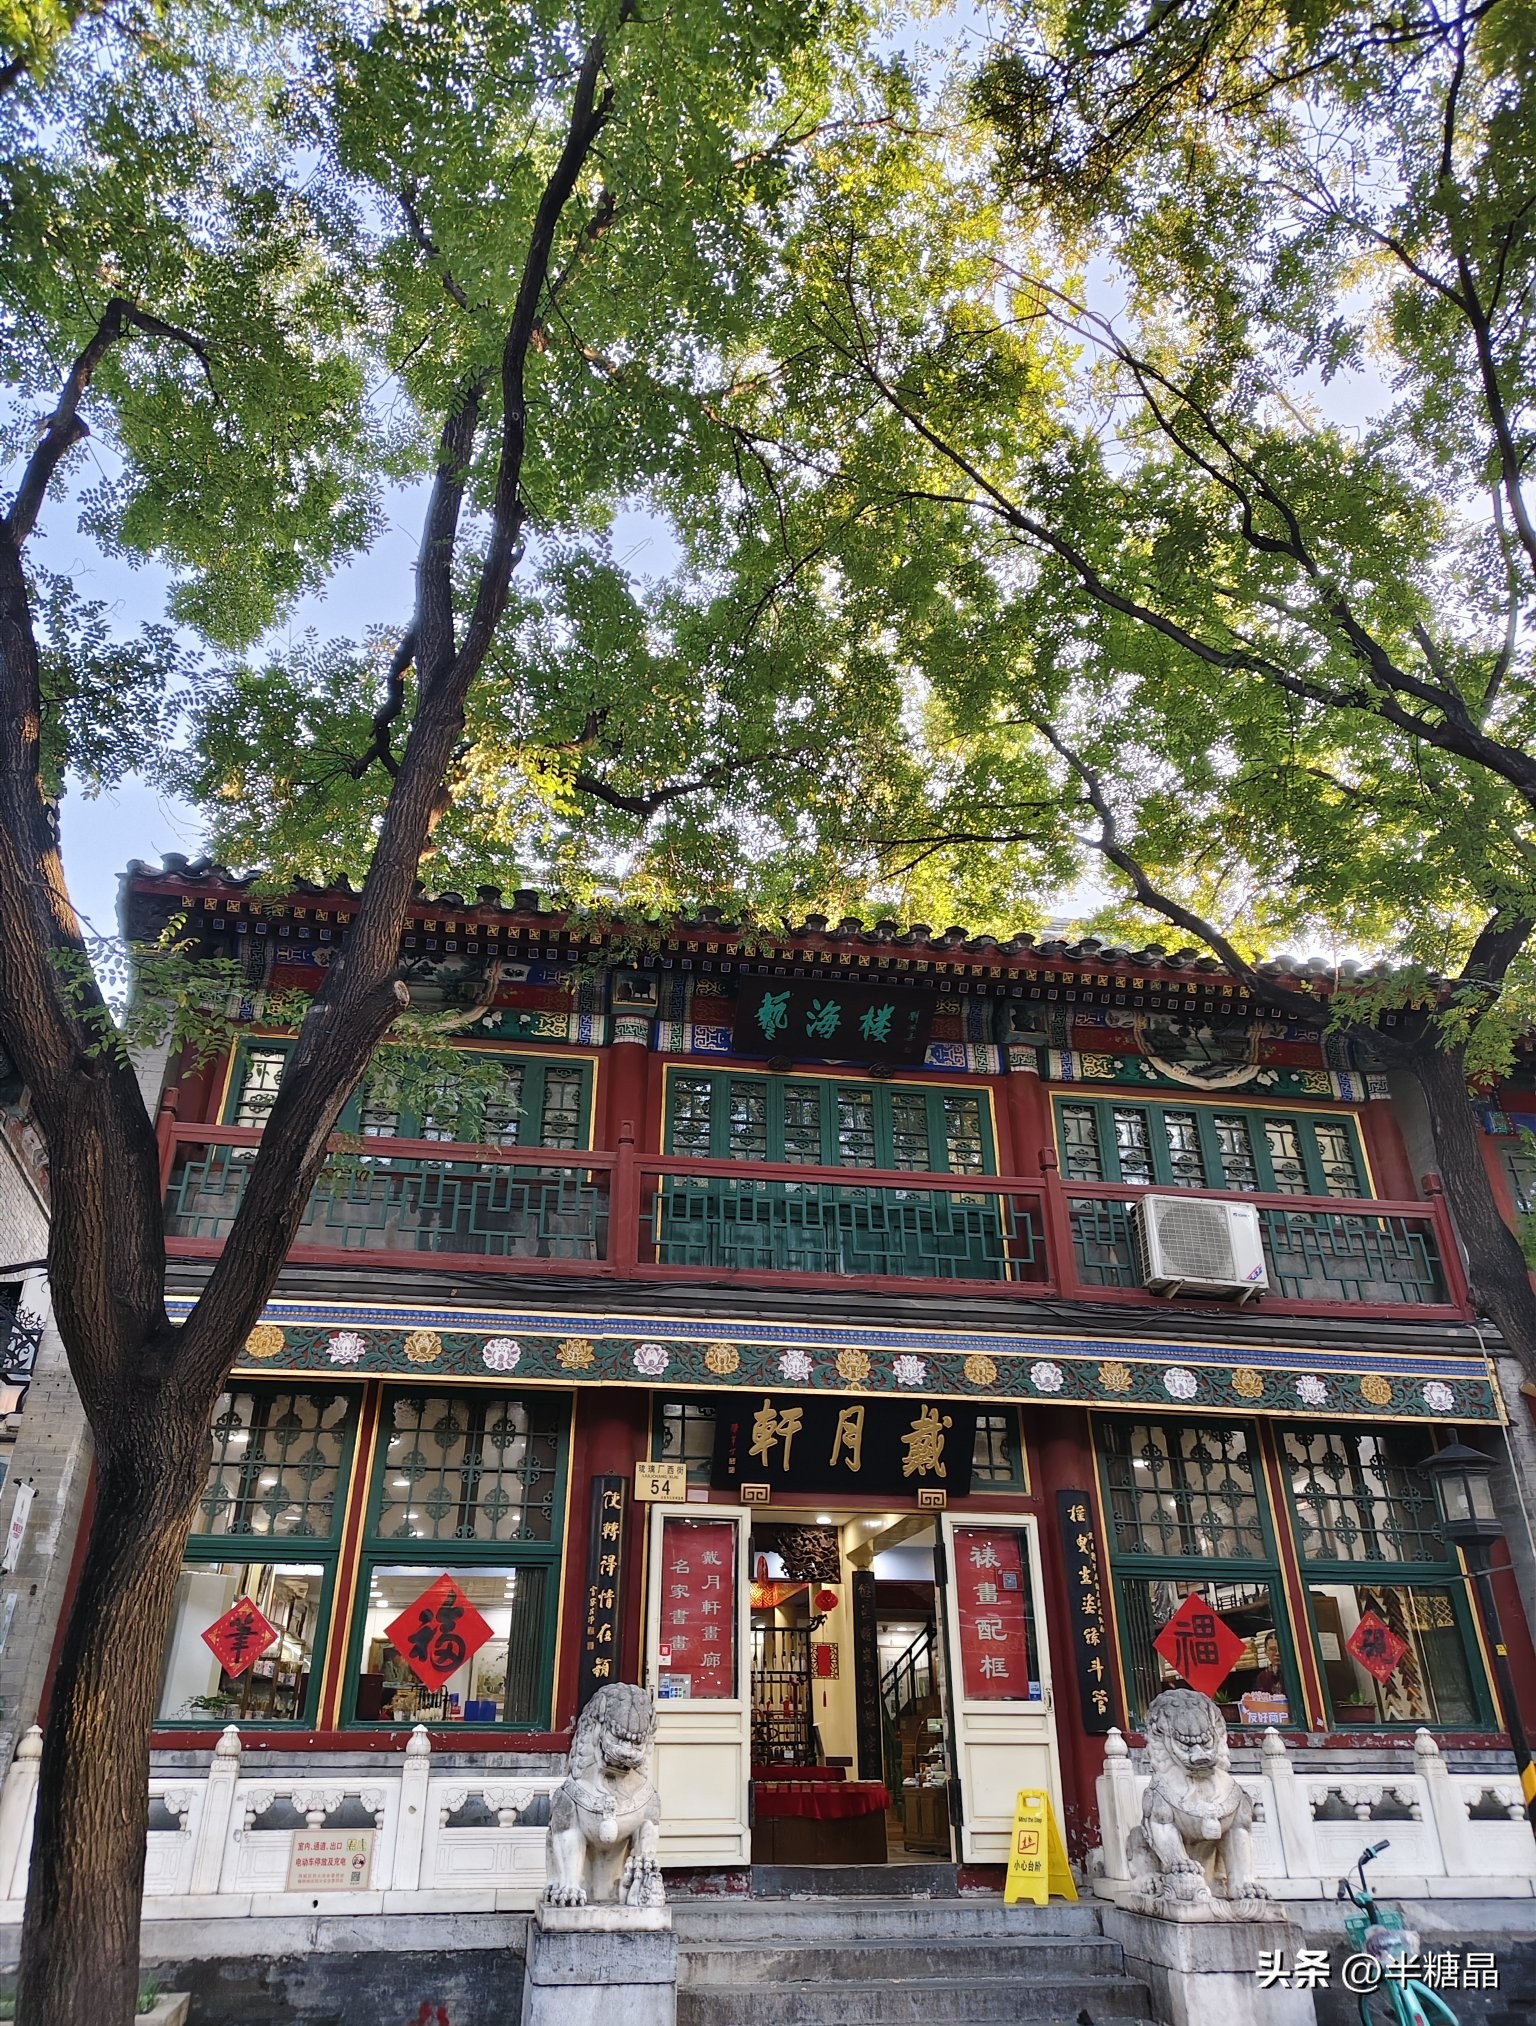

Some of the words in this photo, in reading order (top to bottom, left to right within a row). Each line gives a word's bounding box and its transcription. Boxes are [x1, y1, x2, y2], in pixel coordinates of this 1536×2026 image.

[638, 1464, 684, 1475] 琉璃厂西街
[650, 1479, 670, 1495] 54
[669, 1559, 690, 1651] 名家書畫
[699, 1550, 722, 1668] 戴月軒畫廊
[969, 1546, 1010, 1679] 裱畫配框
[408, 1589, 467, 1673] 福
[1174, 1613, 1220, 1679] 福
[1247, 1711, 1289, 1724] 友好商户
[295, 1857, 347, 1867] 电动车停放及充电
[1014, 1859, 1042, 1872] 小心台阶
